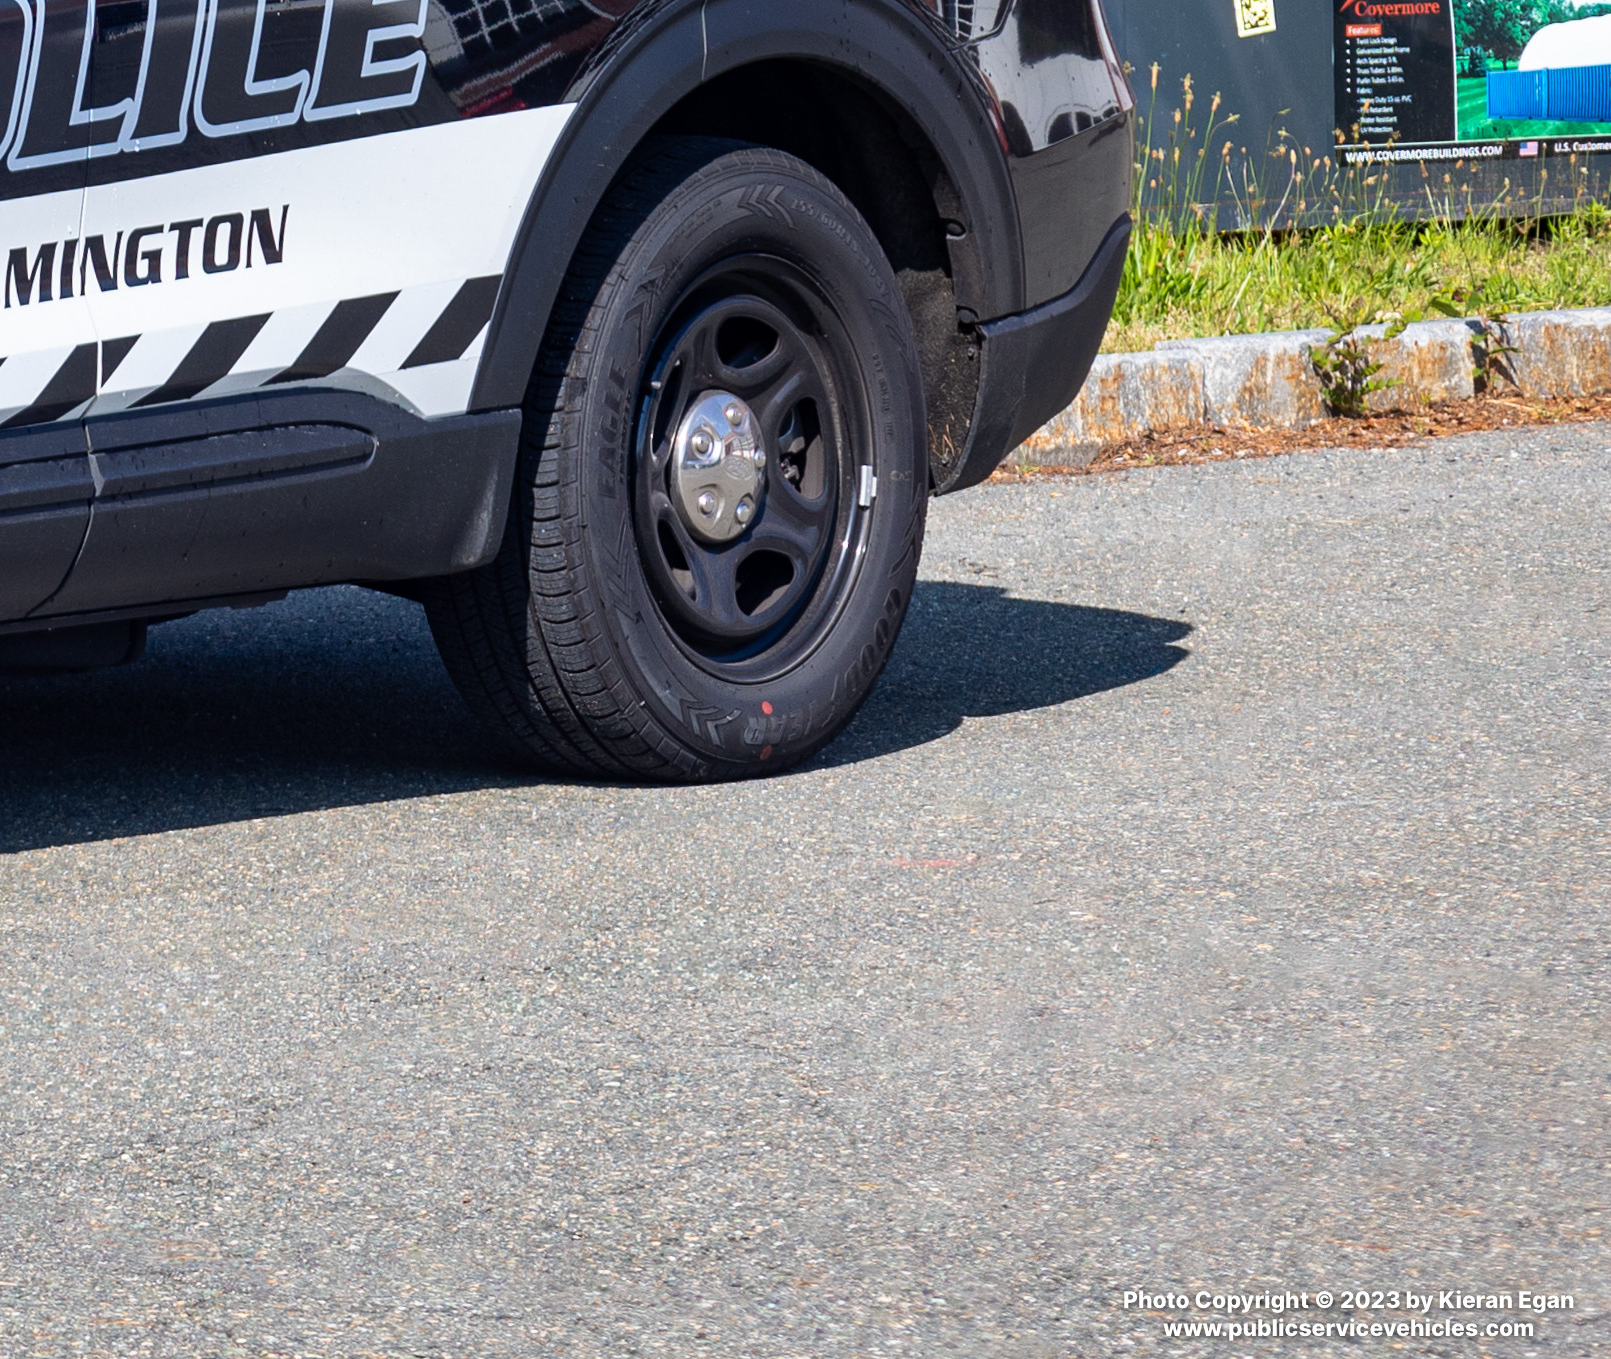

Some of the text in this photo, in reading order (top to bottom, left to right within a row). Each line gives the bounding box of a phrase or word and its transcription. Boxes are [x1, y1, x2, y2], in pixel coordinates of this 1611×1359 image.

[1354, 1, 1440, 16] Covermore
[1345, 145, 1504, 162] WWW.COVERMOREBUILDINGS.COM
[1554, 142, 1571, 152] U.S.
